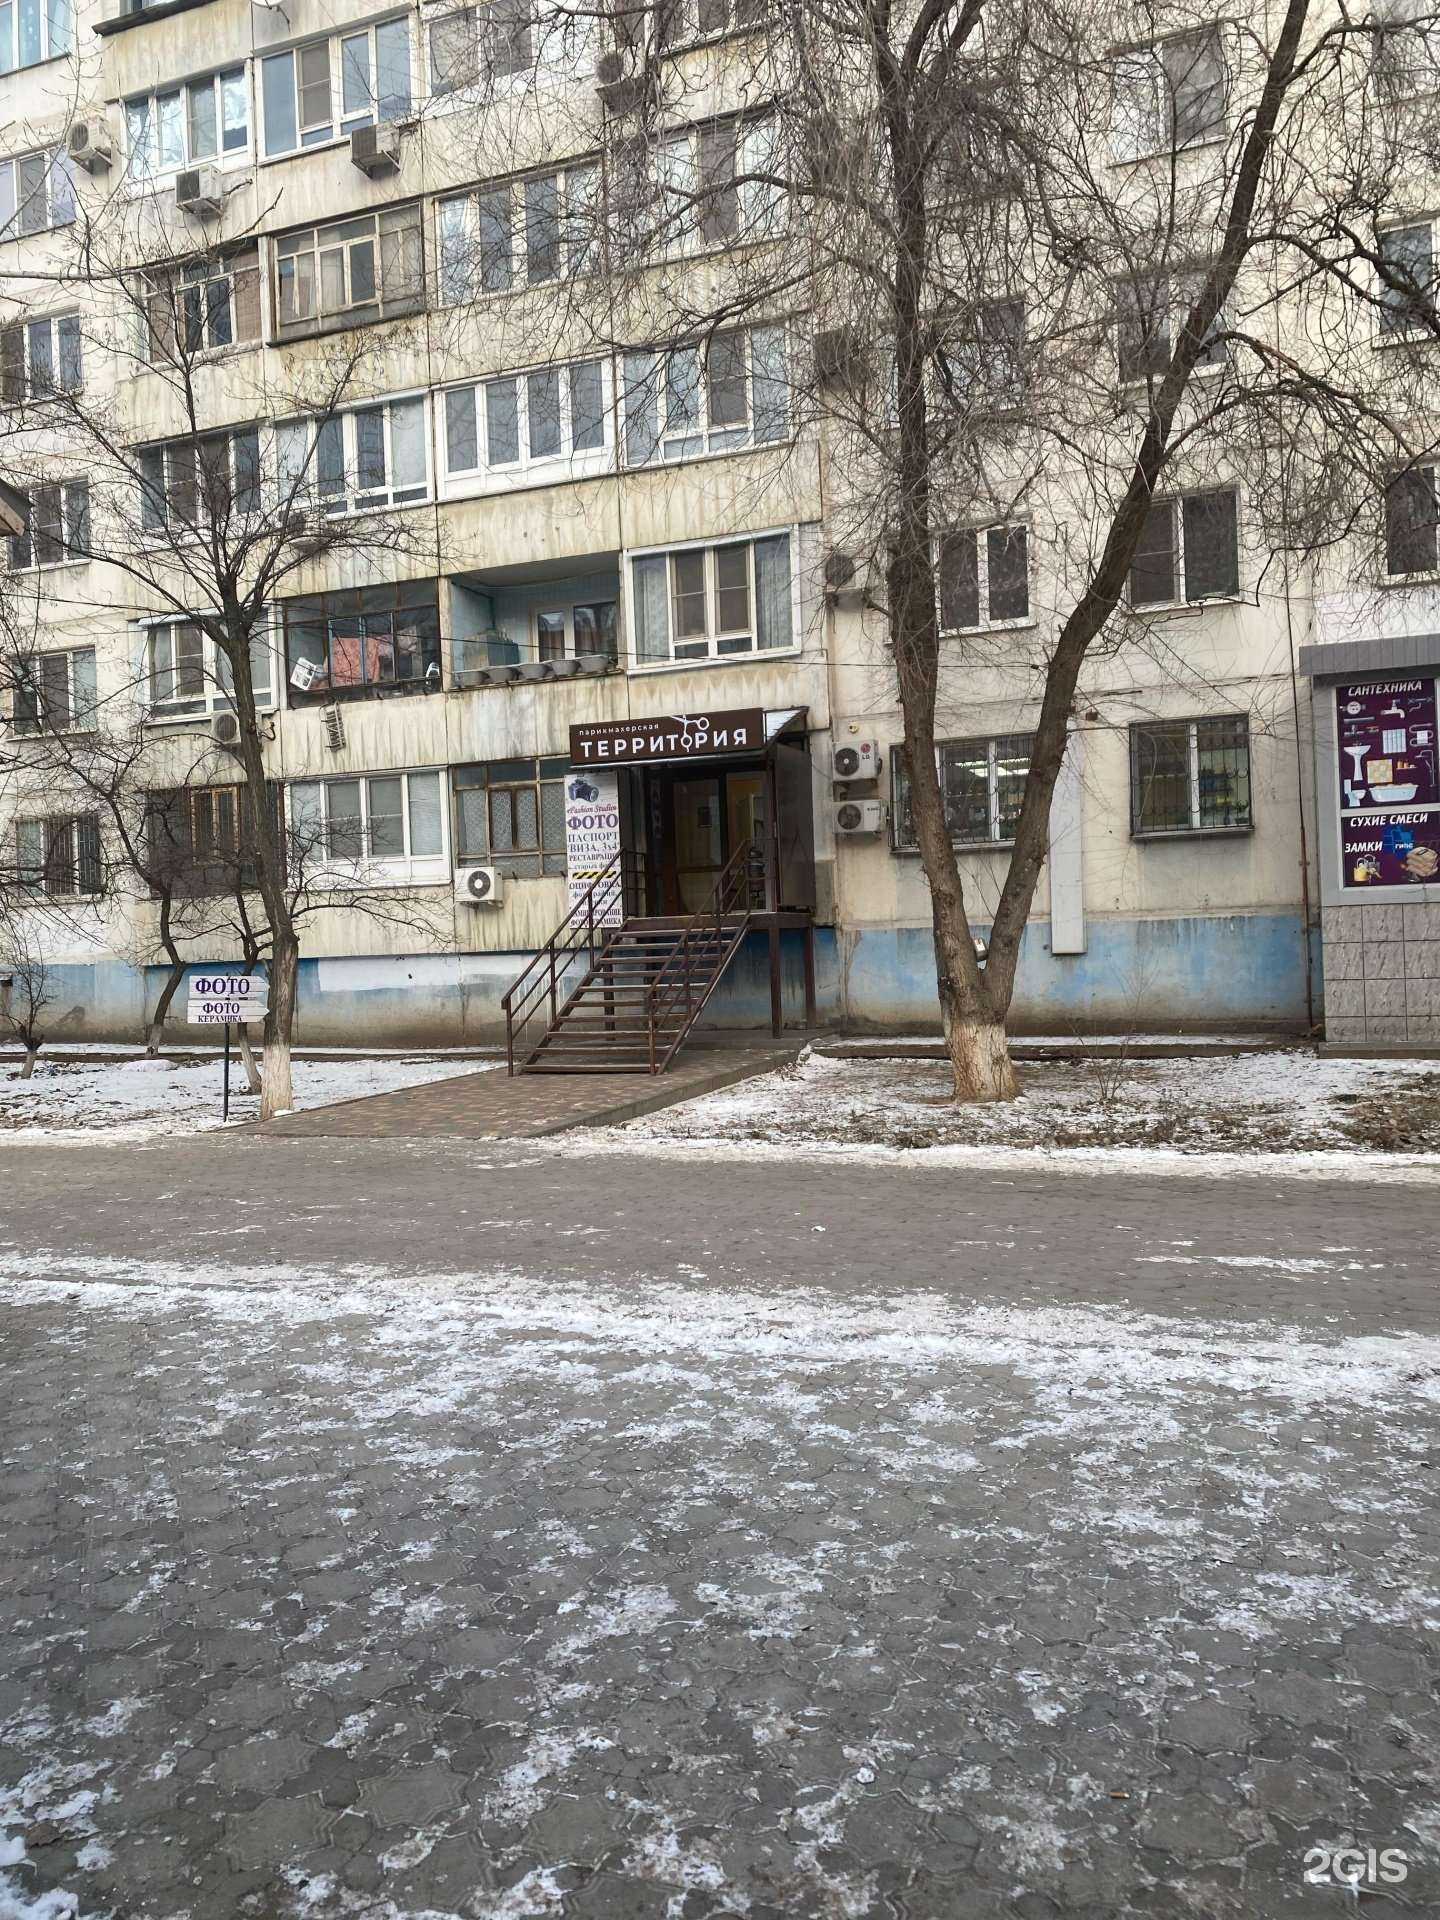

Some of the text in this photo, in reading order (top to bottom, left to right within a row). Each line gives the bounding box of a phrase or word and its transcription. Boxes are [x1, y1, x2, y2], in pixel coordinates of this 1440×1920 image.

[1348, 680, 1422, 697] САНТЕХНИКА
[579, 723, 659, 736] парикмахерская
[580, 728, 747, 758] ТЕРРИТОРИЯ
[567, 813, 619, 830] ФОТО
[1350, 813, 1429, 827] СУХИЕ СМЕСИ
[568, 831, 617, 843] ПАСПОРТ
[1344, 841, 1383, 853] ЗАМКИ
[195, 977, 250, 995] ФОТО
[202, 1002, 240, 1015] ФОТО
[198, 1015, 242, 1023] КЕРАМИКА
